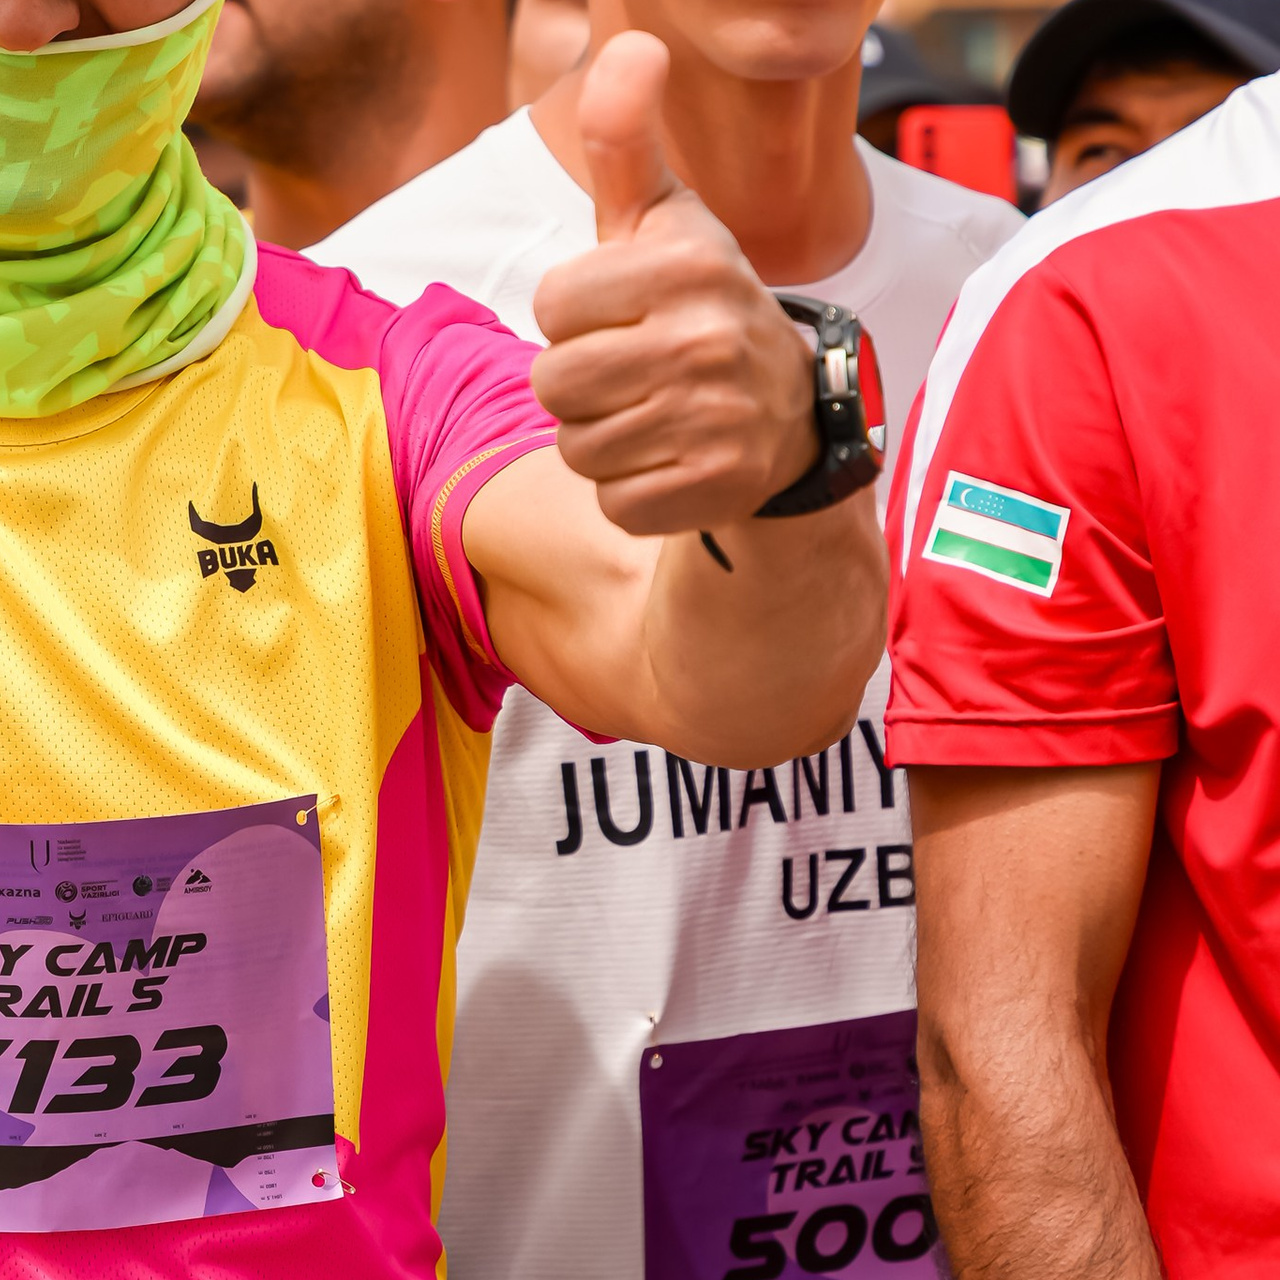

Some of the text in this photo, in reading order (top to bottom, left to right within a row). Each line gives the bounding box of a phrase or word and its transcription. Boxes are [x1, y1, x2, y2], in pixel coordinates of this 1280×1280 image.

[197, 539, 279, 579] BUKA
[81, 891, 120, 899] VAZIRLIGI
[184, 885, 212, 894] AMIRSOY
[782, 844, 915, 920] UZB
[45, 932, 208, 977] CAMP
[740, 1120, 831, 1162] SKY
[771, 1149, 895, 1195] TRAIL
